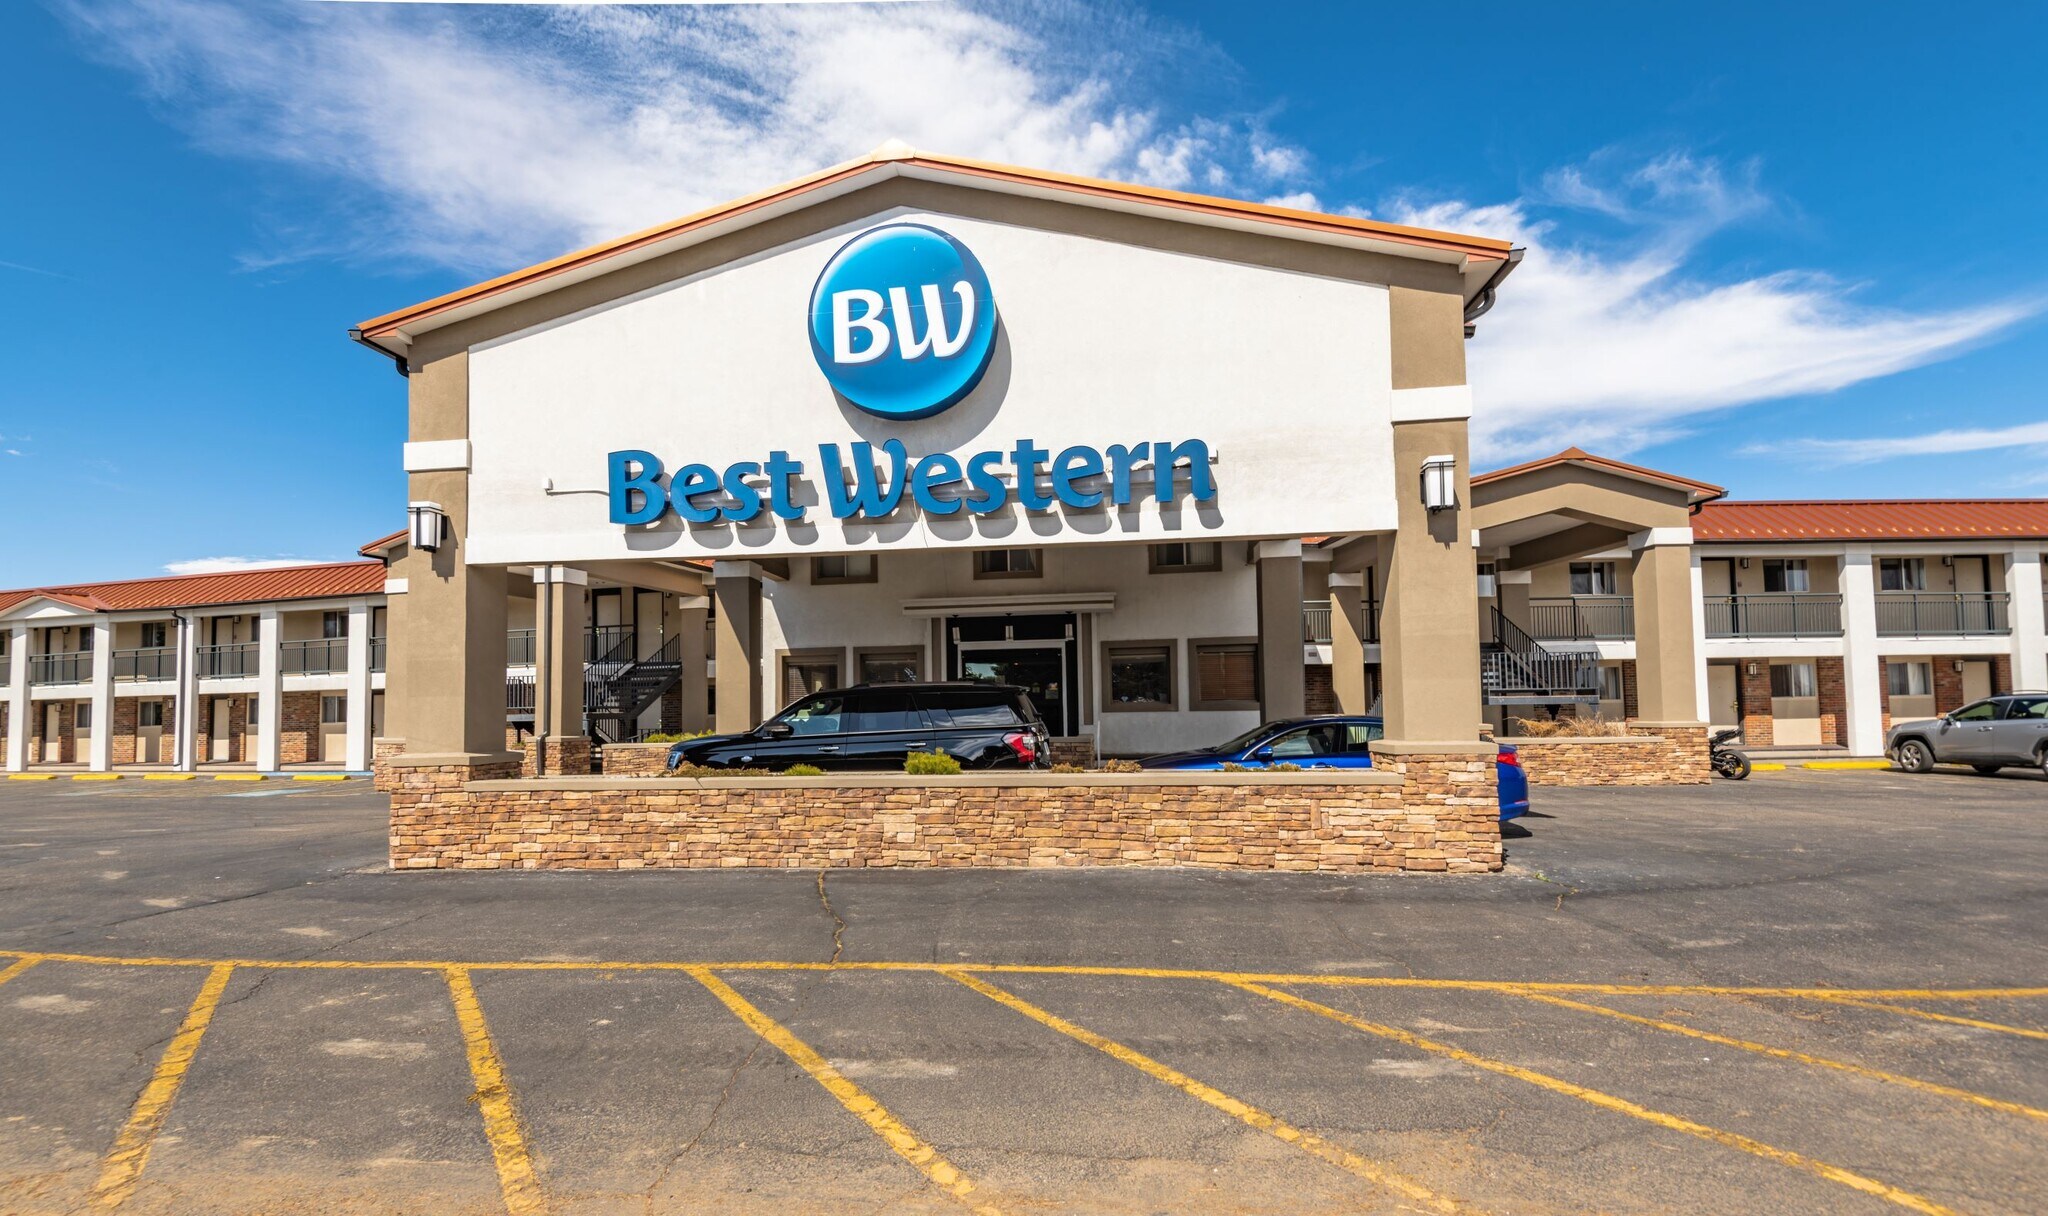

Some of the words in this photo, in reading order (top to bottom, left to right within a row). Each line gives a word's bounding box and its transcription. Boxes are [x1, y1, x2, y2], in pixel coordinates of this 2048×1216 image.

[831, 281, 975, 364] BW
[607, 449, 805, 526] Best
[817, 438, 1216, 519] Western
